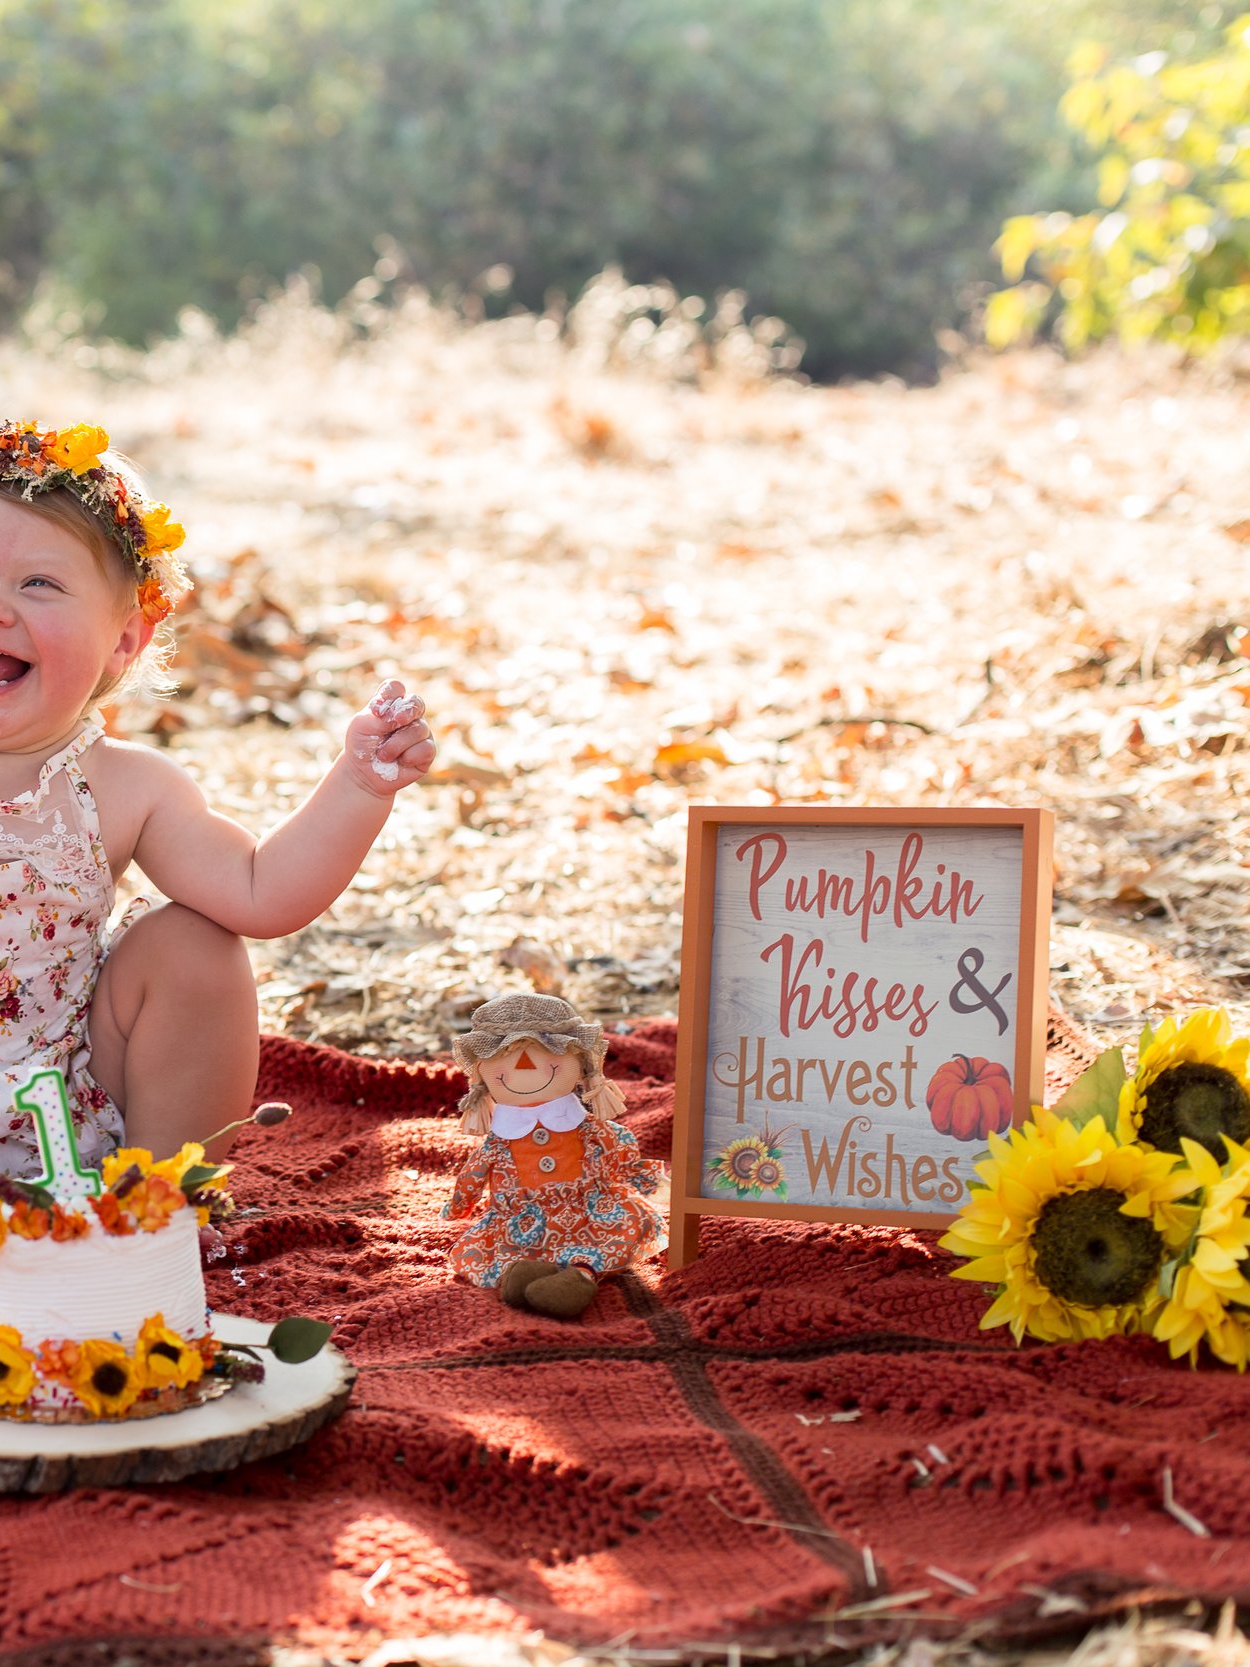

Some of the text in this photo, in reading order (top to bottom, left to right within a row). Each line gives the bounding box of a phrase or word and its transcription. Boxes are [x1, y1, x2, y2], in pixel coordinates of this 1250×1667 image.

[736, 832, 985, 943] Pumpkin
[760, 933, 1012, 1039] Kisses &
[12, 1066, 102, 1197] 1
[712, 1036, 918, 1124] Harvest
[801, 1115, 965, 1206] Wishes
